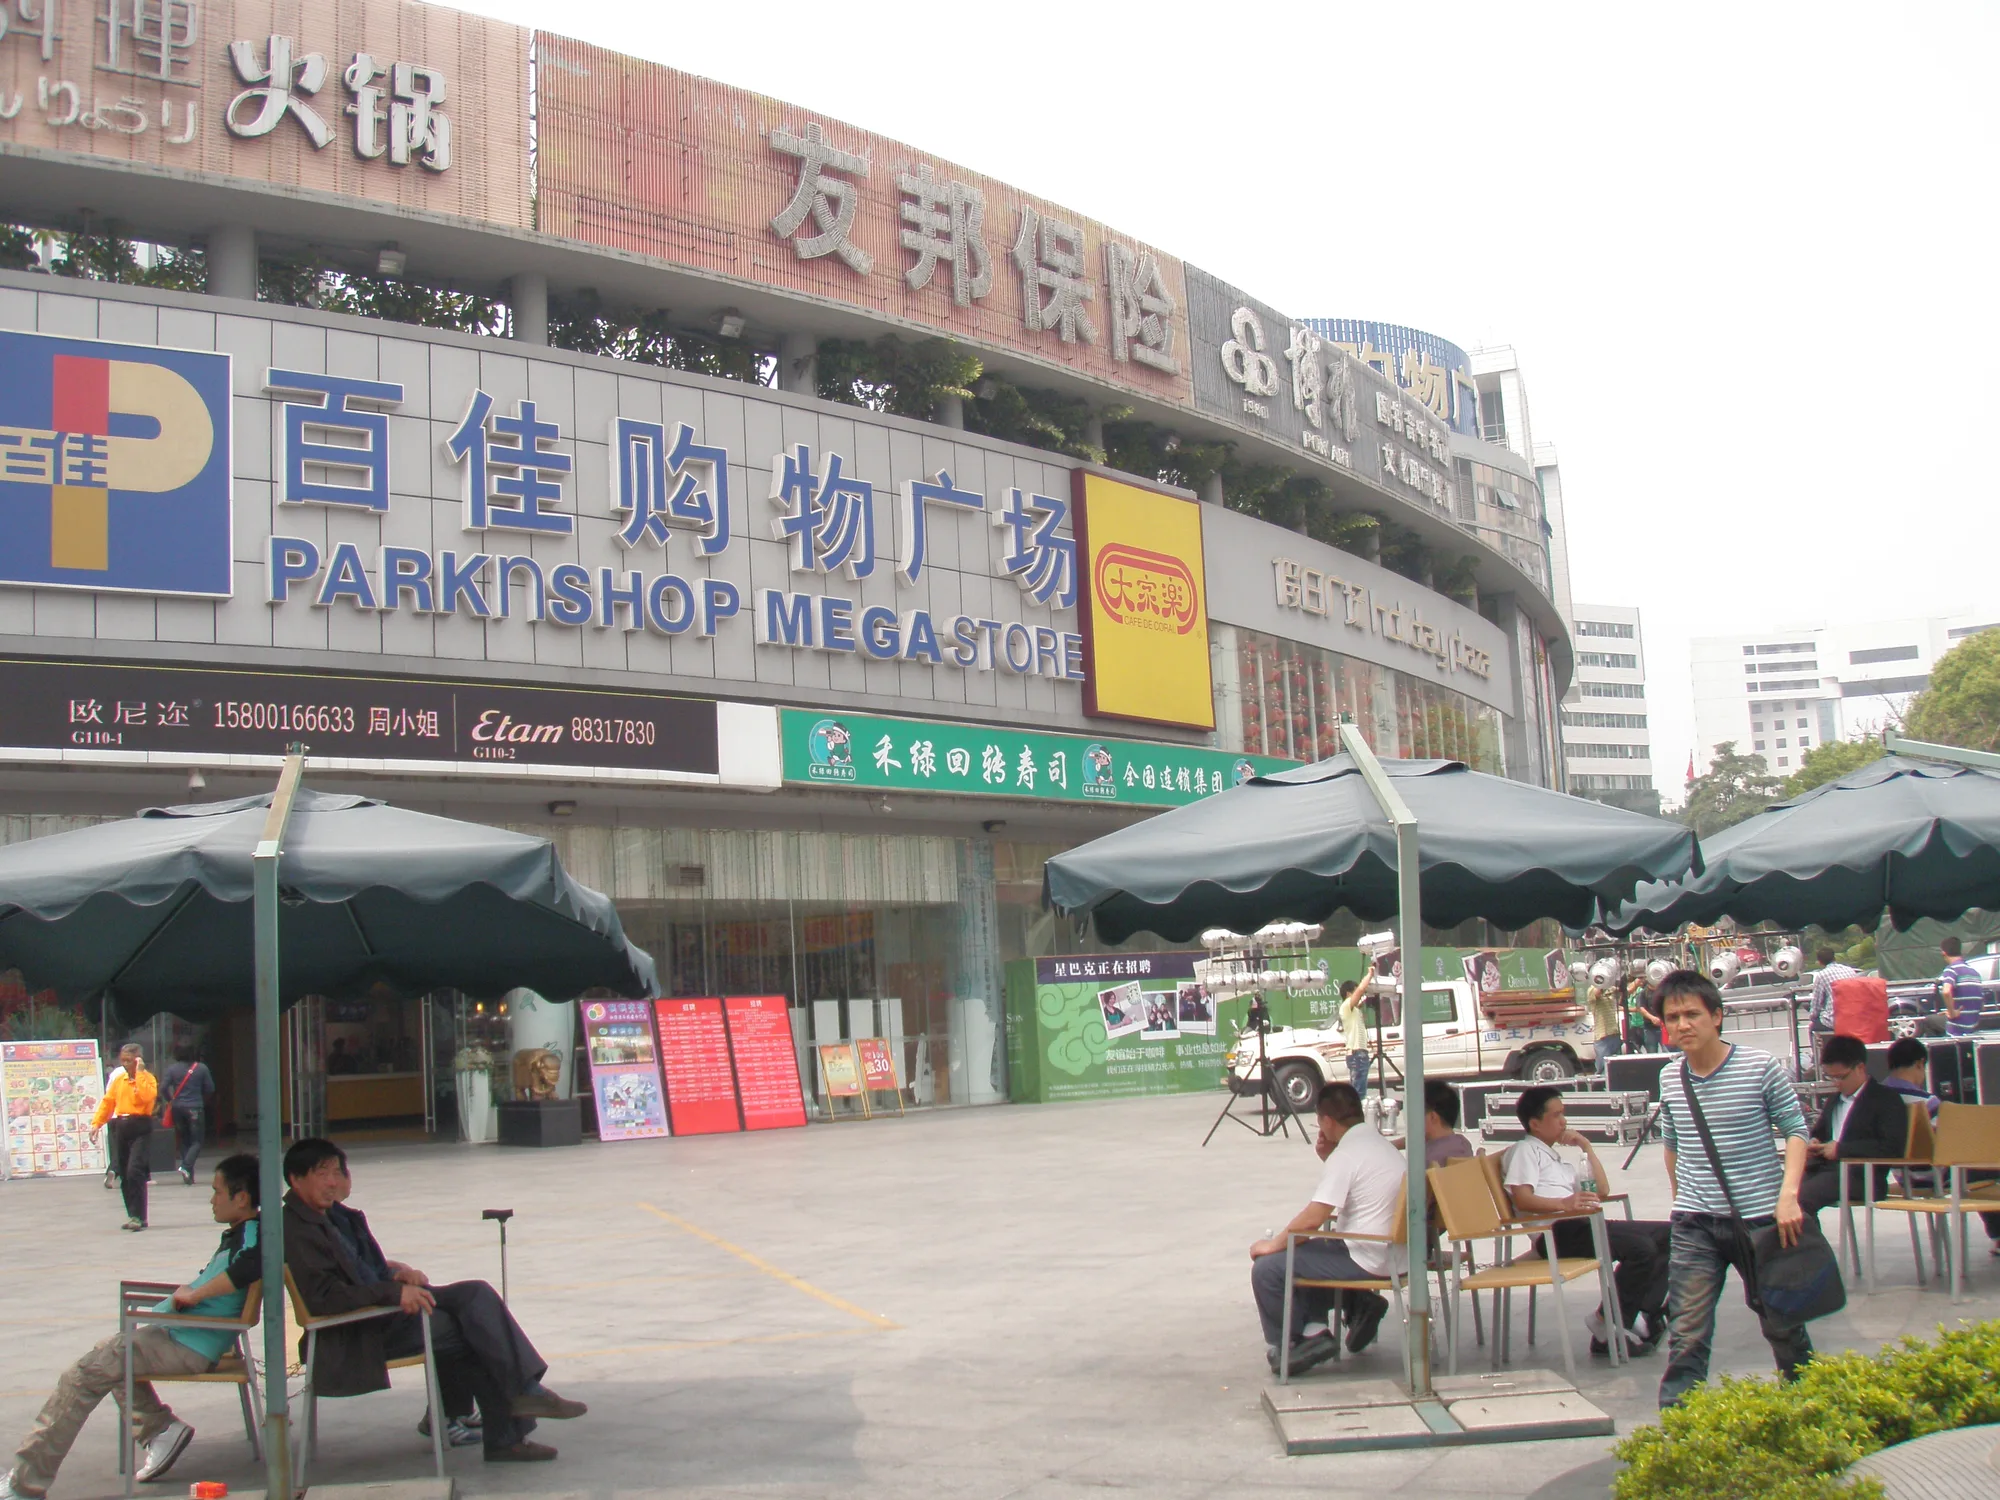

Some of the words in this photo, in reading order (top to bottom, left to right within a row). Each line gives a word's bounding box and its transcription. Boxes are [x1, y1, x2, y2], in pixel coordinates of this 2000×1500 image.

[225, 34, 453, 172] 火锅
[768, 121, 1182, 377] 友邦保险
[262, 366, 1078, 611] 百佳购物广场
[1124, 615, 1142, 628] CAFE
[1143, 620, 1154, 630] DE
[1154, 622, 1177, 635] CORAL
[213, 702, 355, 732] 15800166633
[367, 706, 440, 737] 周小姐
[471, 709, 564, 743] Etam
[571, 716, 655, 745] 88317830
[71, 731, 123, 744] G110-1
[473, 746, 516, 760] G110-2
[872, 734, 1068, 790] 禾绿回转寿司
[1122, 761, 1223, 795] 全国连锁集团
[1054, 959, 1151, 977] 星巴克正在招聘
[1105, 1046, 1165, 1061] 友谊始于咖啡
[1175, 1041, 1228, 1056] 事业也是如此
